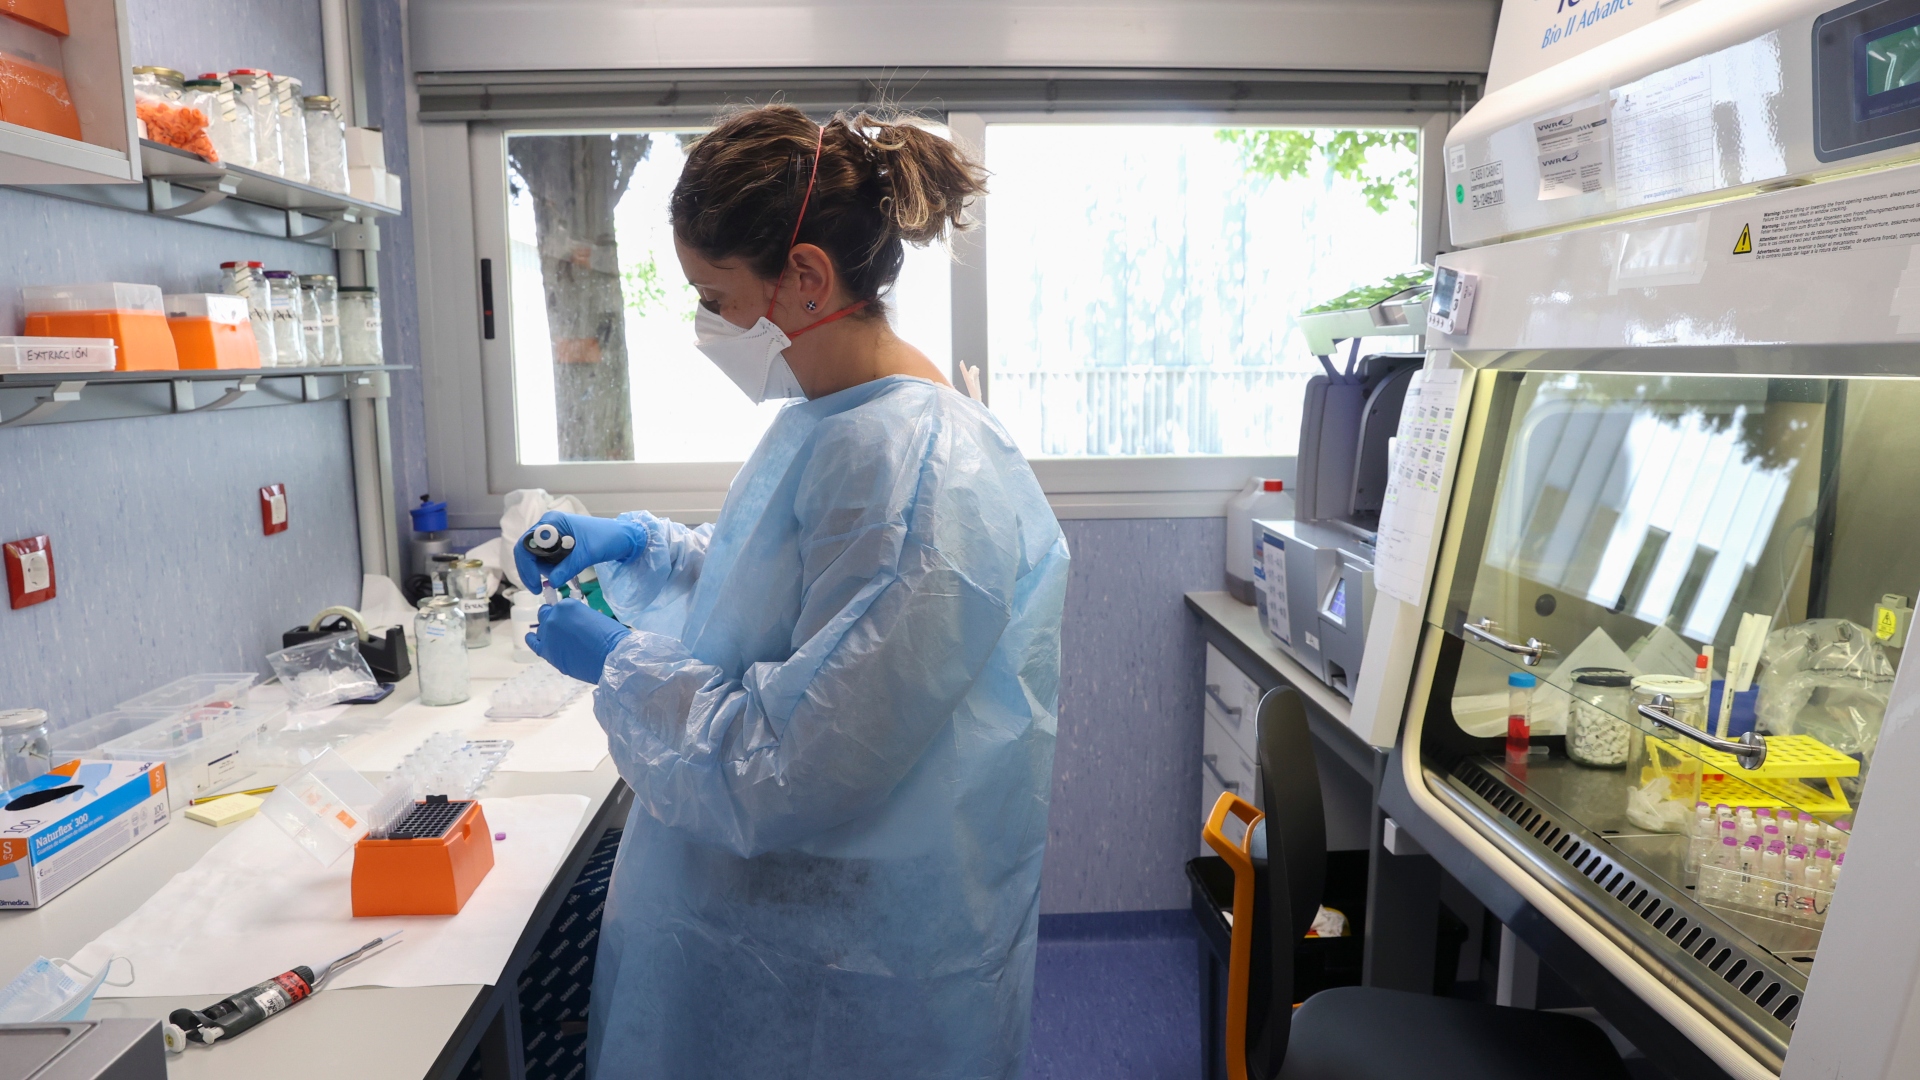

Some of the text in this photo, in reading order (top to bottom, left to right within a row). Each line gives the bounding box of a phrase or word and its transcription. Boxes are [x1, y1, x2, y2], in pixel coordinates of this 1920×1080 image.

[1542, 24, 1561, 49] Bio
[1538, 122, 1557, 131] VWR
[1542, 158, 1561, 166] VWR
[1863, 194, 1888, 202] mechanism,
[27, 347, 88, 361] EXTRACCIÓN
[155, 771, 161, 780] S
[154, 803, 164, 815] 100
[74, 813, 88, 828] 300
[3, 842, 12, 854] S
[37, 843, 53, 855] Guantes
[559, 912, 579, 933] QIAGEN
[578, 928, 598, 949] QIAGEN
[549, 939, 570, 960] QIAGEN
[568, 955, 589, 976] QIAGEN
[541, 967, 561, 986] QIAGEN
[560, 982, 580, 1001] QIAGEN
[532, 992, 552, 1012] QIAGEN
[527, 1031, 546, 1051] QIAGEN
[554, 1031, 563, 1040] QIA
[545, 1047, 565, 1067] QIAGEN
